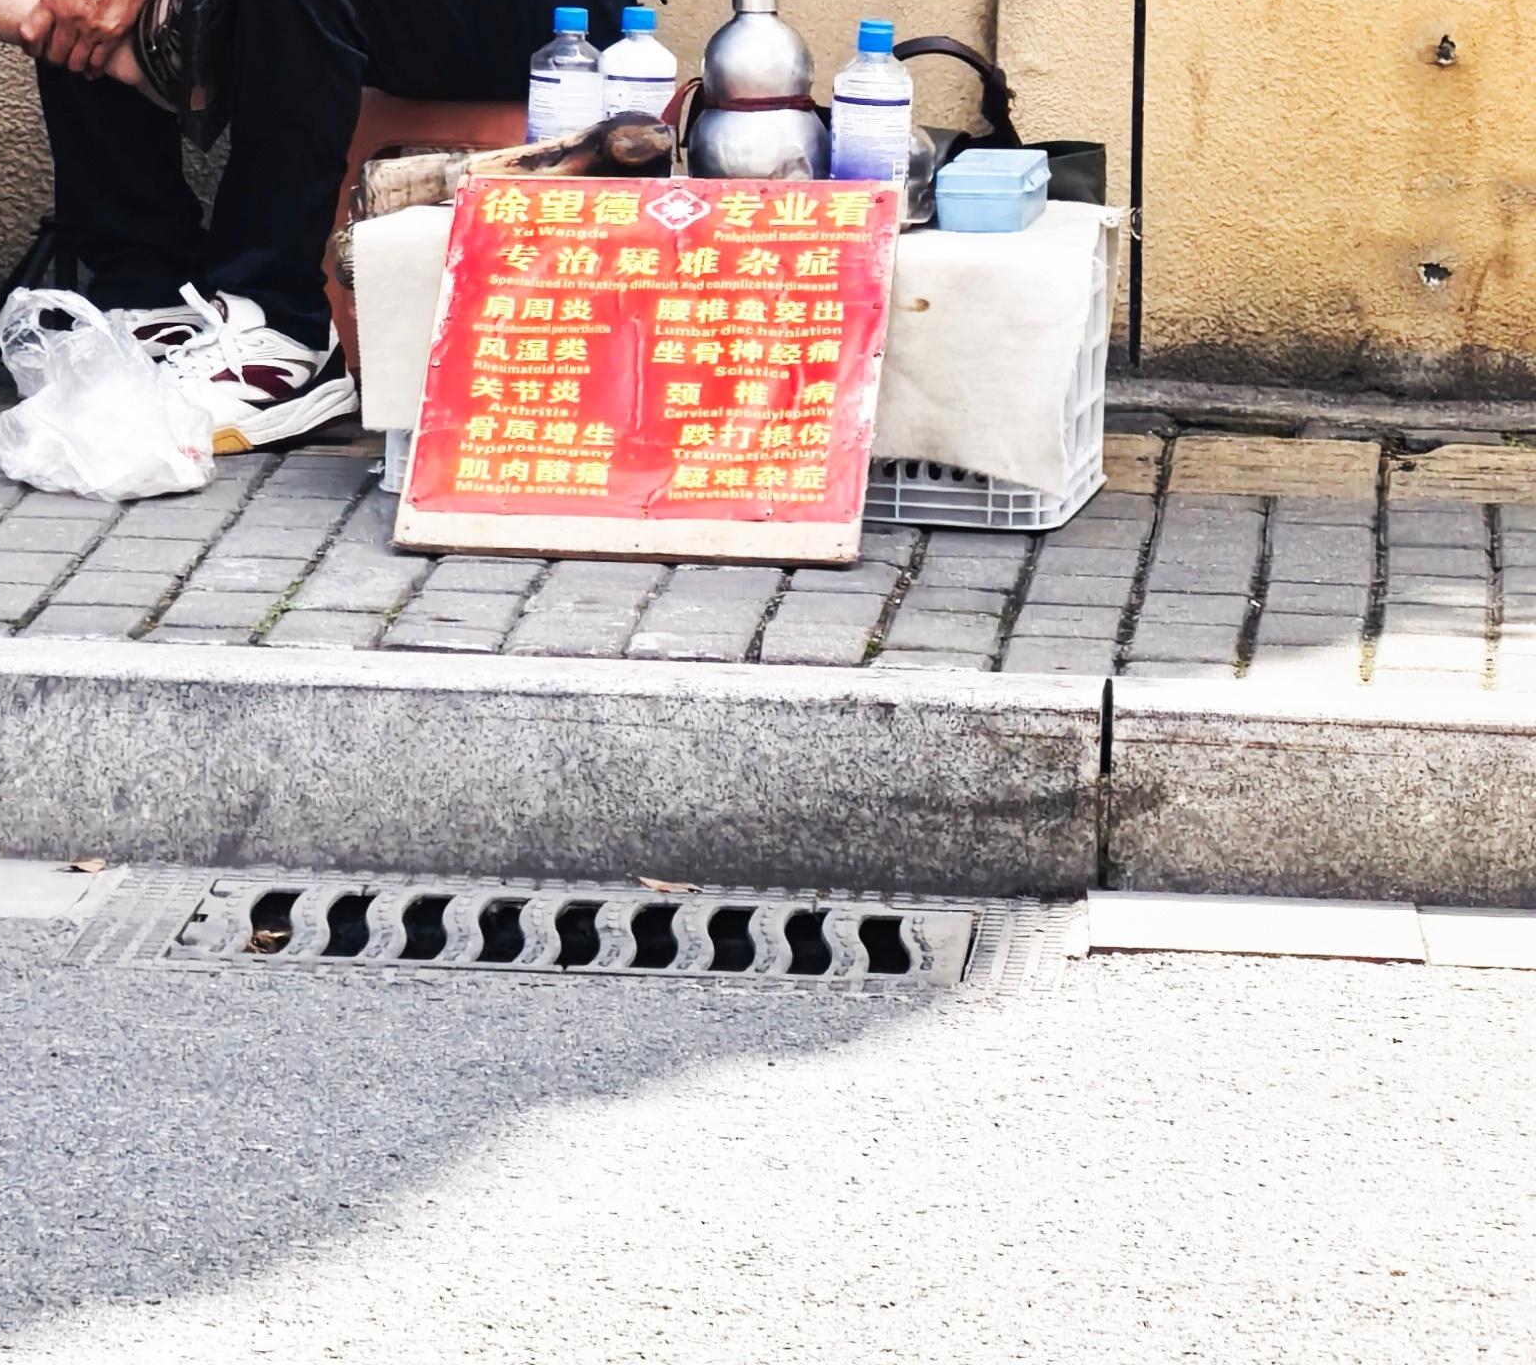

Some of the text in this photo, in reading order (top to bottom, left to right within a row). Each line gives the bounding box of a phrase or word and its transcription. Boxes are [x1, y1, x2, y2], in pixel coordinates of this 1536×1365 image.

[482, 187, 875, 228] 徐望德 专业看
[538, 226, 609, 239] Wangde
[714, 230, 872, 243] Professional medical treatment
[497, 244, 842, 277] 专治疑难杂症
[489, 274, 838, 292] Specialized in treating difficult and complicated diseases
[482, 294, 592, 321] 肩周炎
[655, 298, 844, 324] 腰椎盘突出
[655, 325, 843, 338] Lumbar disc herniation
[475, 337, 589, 361] 风湿类
[652, 339, 843, 365] 坐骨神经痛
[473, 359, 590, 374] Rheumatoid class
[714, 366, 790, 379] Sciatica
[470, 376, 581, 403] 关节炎
[666, 380, 837, 406] 颈椎病
[488, 402, 570, 417] Arthritis
[664, 406, 836, 422] Cervical spondylopathy
[465, 416, 615, 446] 骨质增生
[679, 422, 832, 449] 跌打损伤
[460, 441, 614, 460] Hyperosteogeny
[456, 457, 611, 485] 肌肉酸痛
[672, 465, 828, 490] 疑难杂症
[455, 480, 609, 496] Muscle soreness
